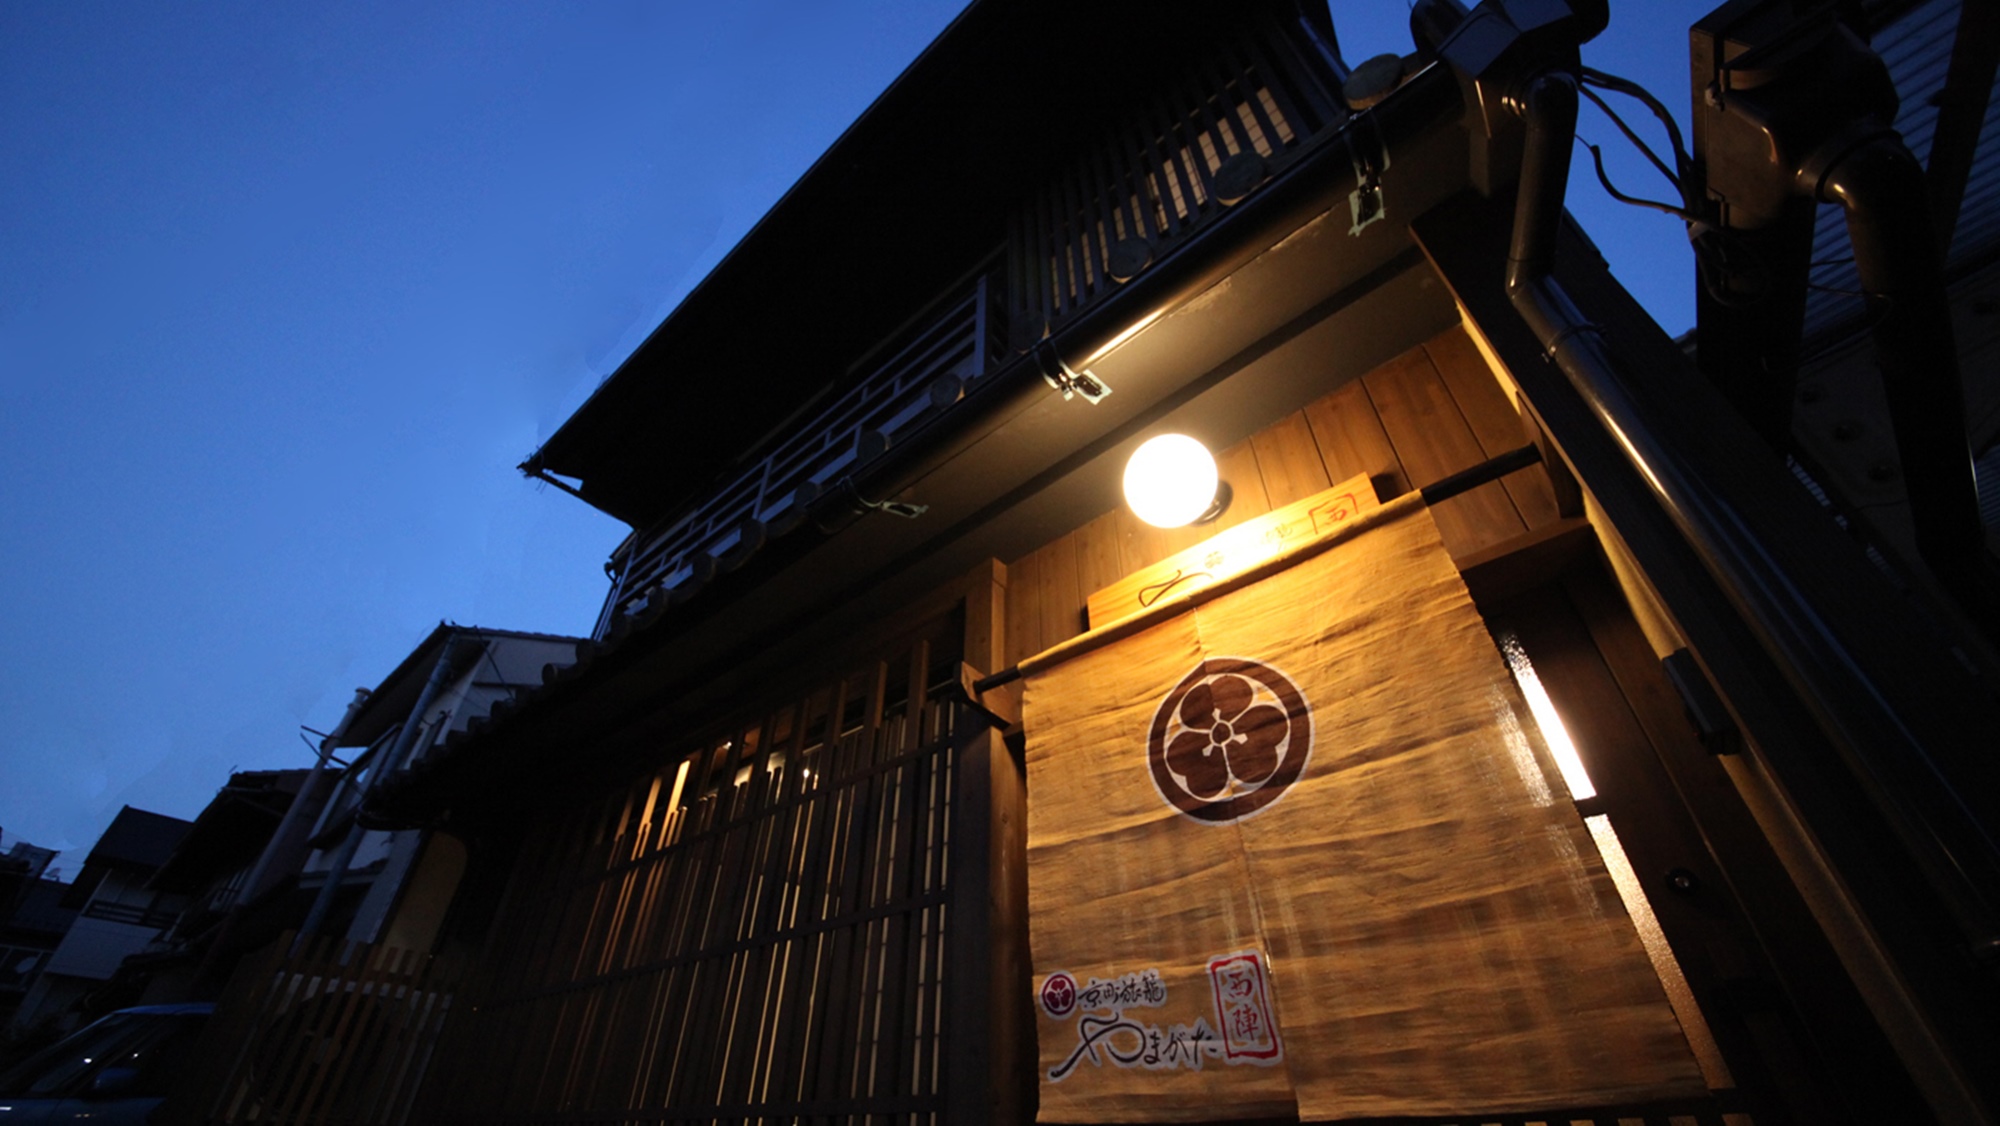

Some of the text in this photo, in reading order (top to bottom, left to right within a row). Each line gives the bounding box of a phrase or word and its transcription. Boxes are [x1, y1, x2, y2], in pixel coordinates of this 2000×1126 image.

[1227, 971, 1259, 1041] 西陣
[1050, 1012, 1217, 1078] やまがた
